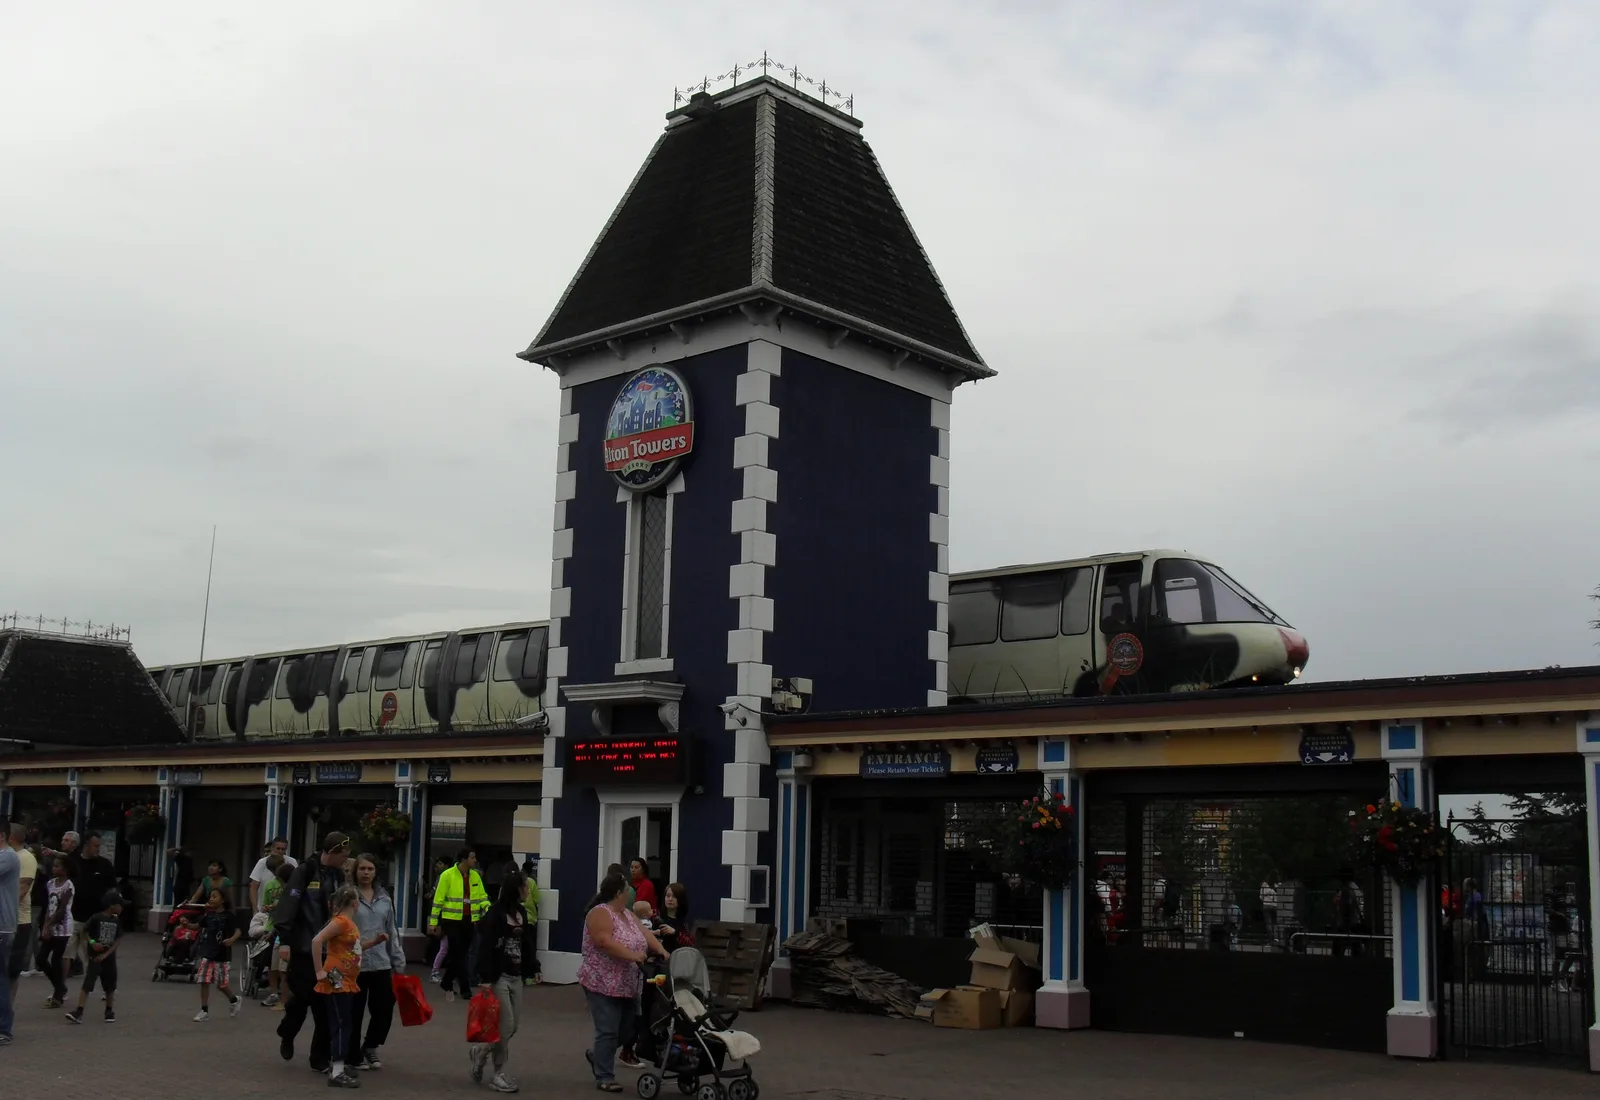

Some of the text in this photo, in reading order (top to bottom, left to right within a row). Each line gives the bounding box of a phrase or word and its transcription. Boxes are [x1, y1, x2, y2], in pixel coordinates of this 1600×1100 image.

[604, 436, 686, 464] Alton Towers
[623, 461, 649, 474] RESORT
[867, 751, 942, 765] ENTRANCE
[868, 766, 886, 774] Please
[887, 766, 906, 774] Retain
